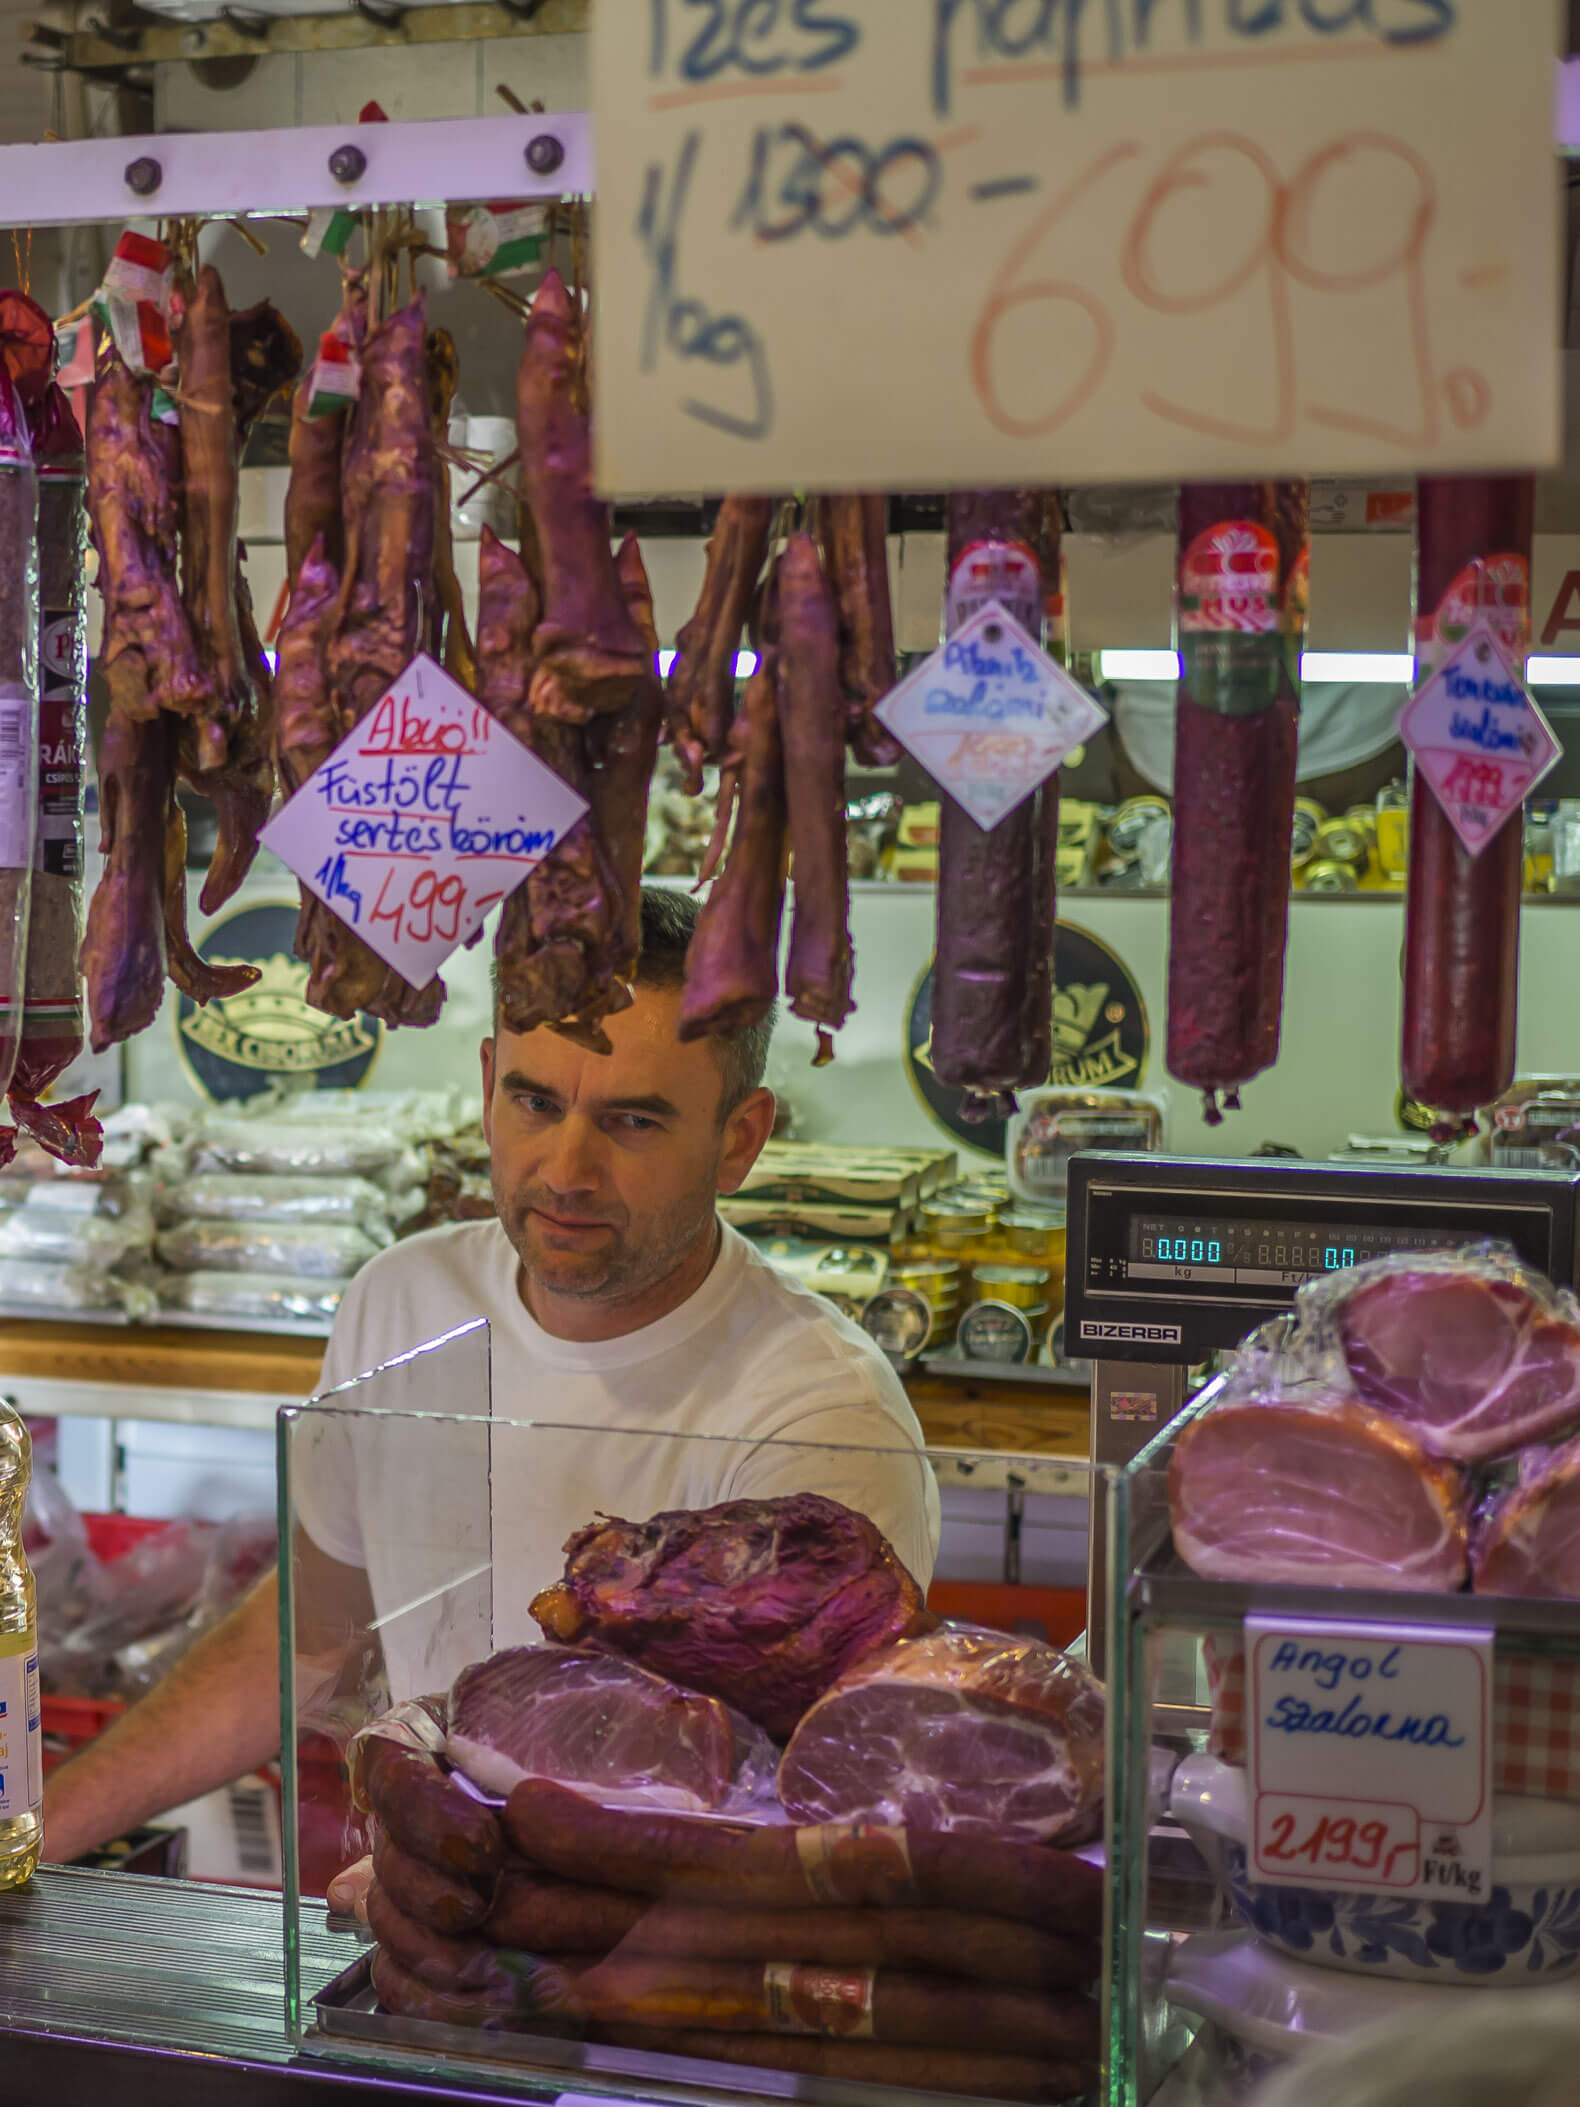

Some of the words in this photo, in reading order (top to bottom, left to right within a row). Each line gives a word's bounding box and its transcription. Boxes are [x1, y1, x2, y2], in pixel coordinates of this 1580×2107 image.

[1158, 1238, 1220, 1262] 0.000
[1174, 1267, 1192, 1279] kg
[1083, 1324, 1179, 1341] BIZERBA
